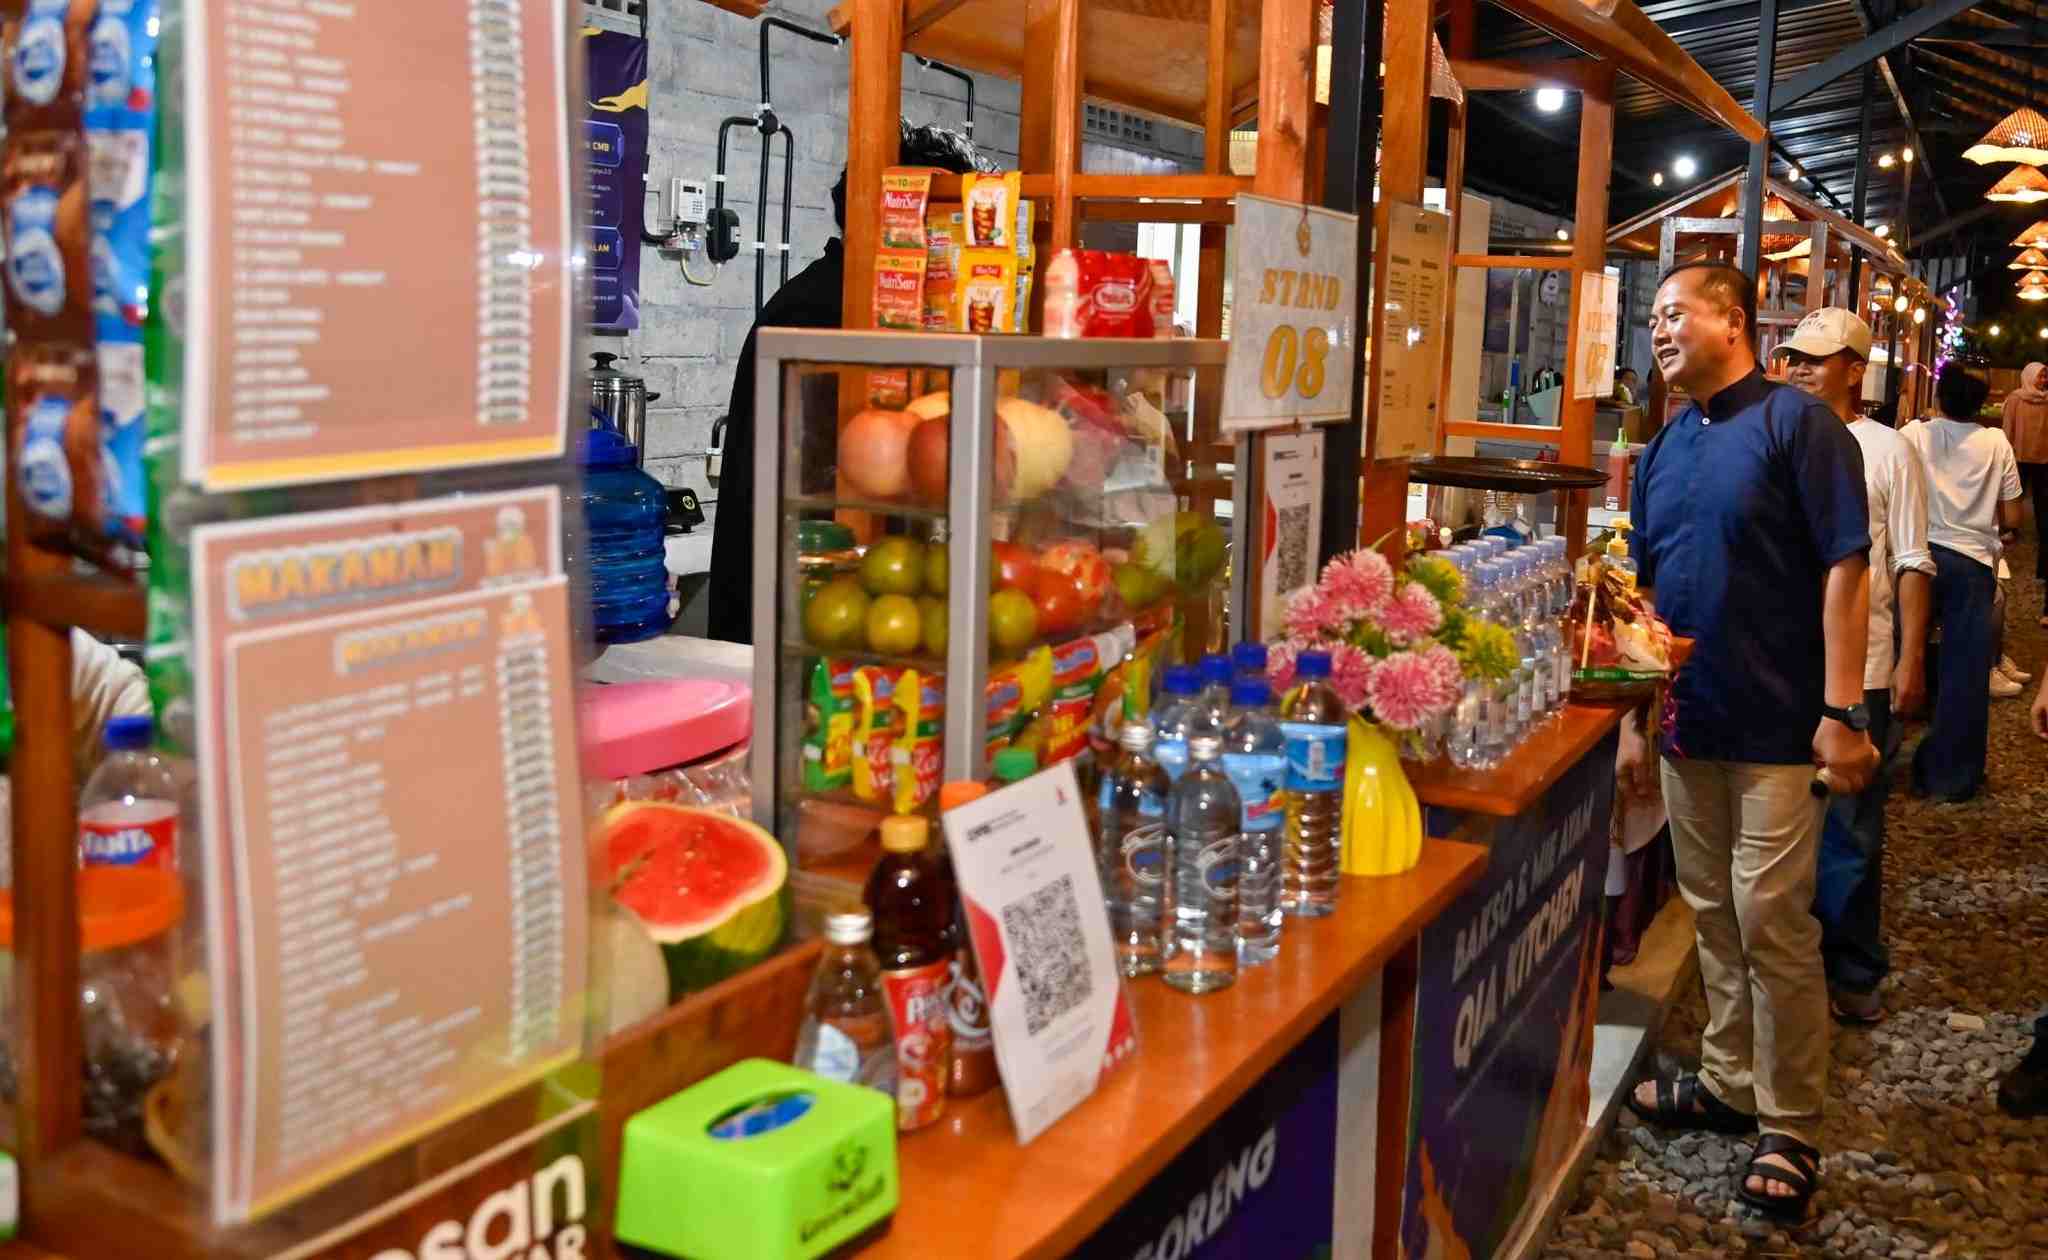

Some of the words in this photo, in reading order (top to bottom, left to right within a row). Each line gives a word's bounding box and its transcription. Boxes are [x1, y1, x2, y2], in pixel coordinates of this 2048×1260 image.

[1259, 267, 1340, 310] STAND
[1260, 323, 1330, 400] 08
[1452, 877, 1514, 984] BAKSO
[1503, 857, 1586, 1010] KITCHEN
[368, 1154, 588, 1260] san
